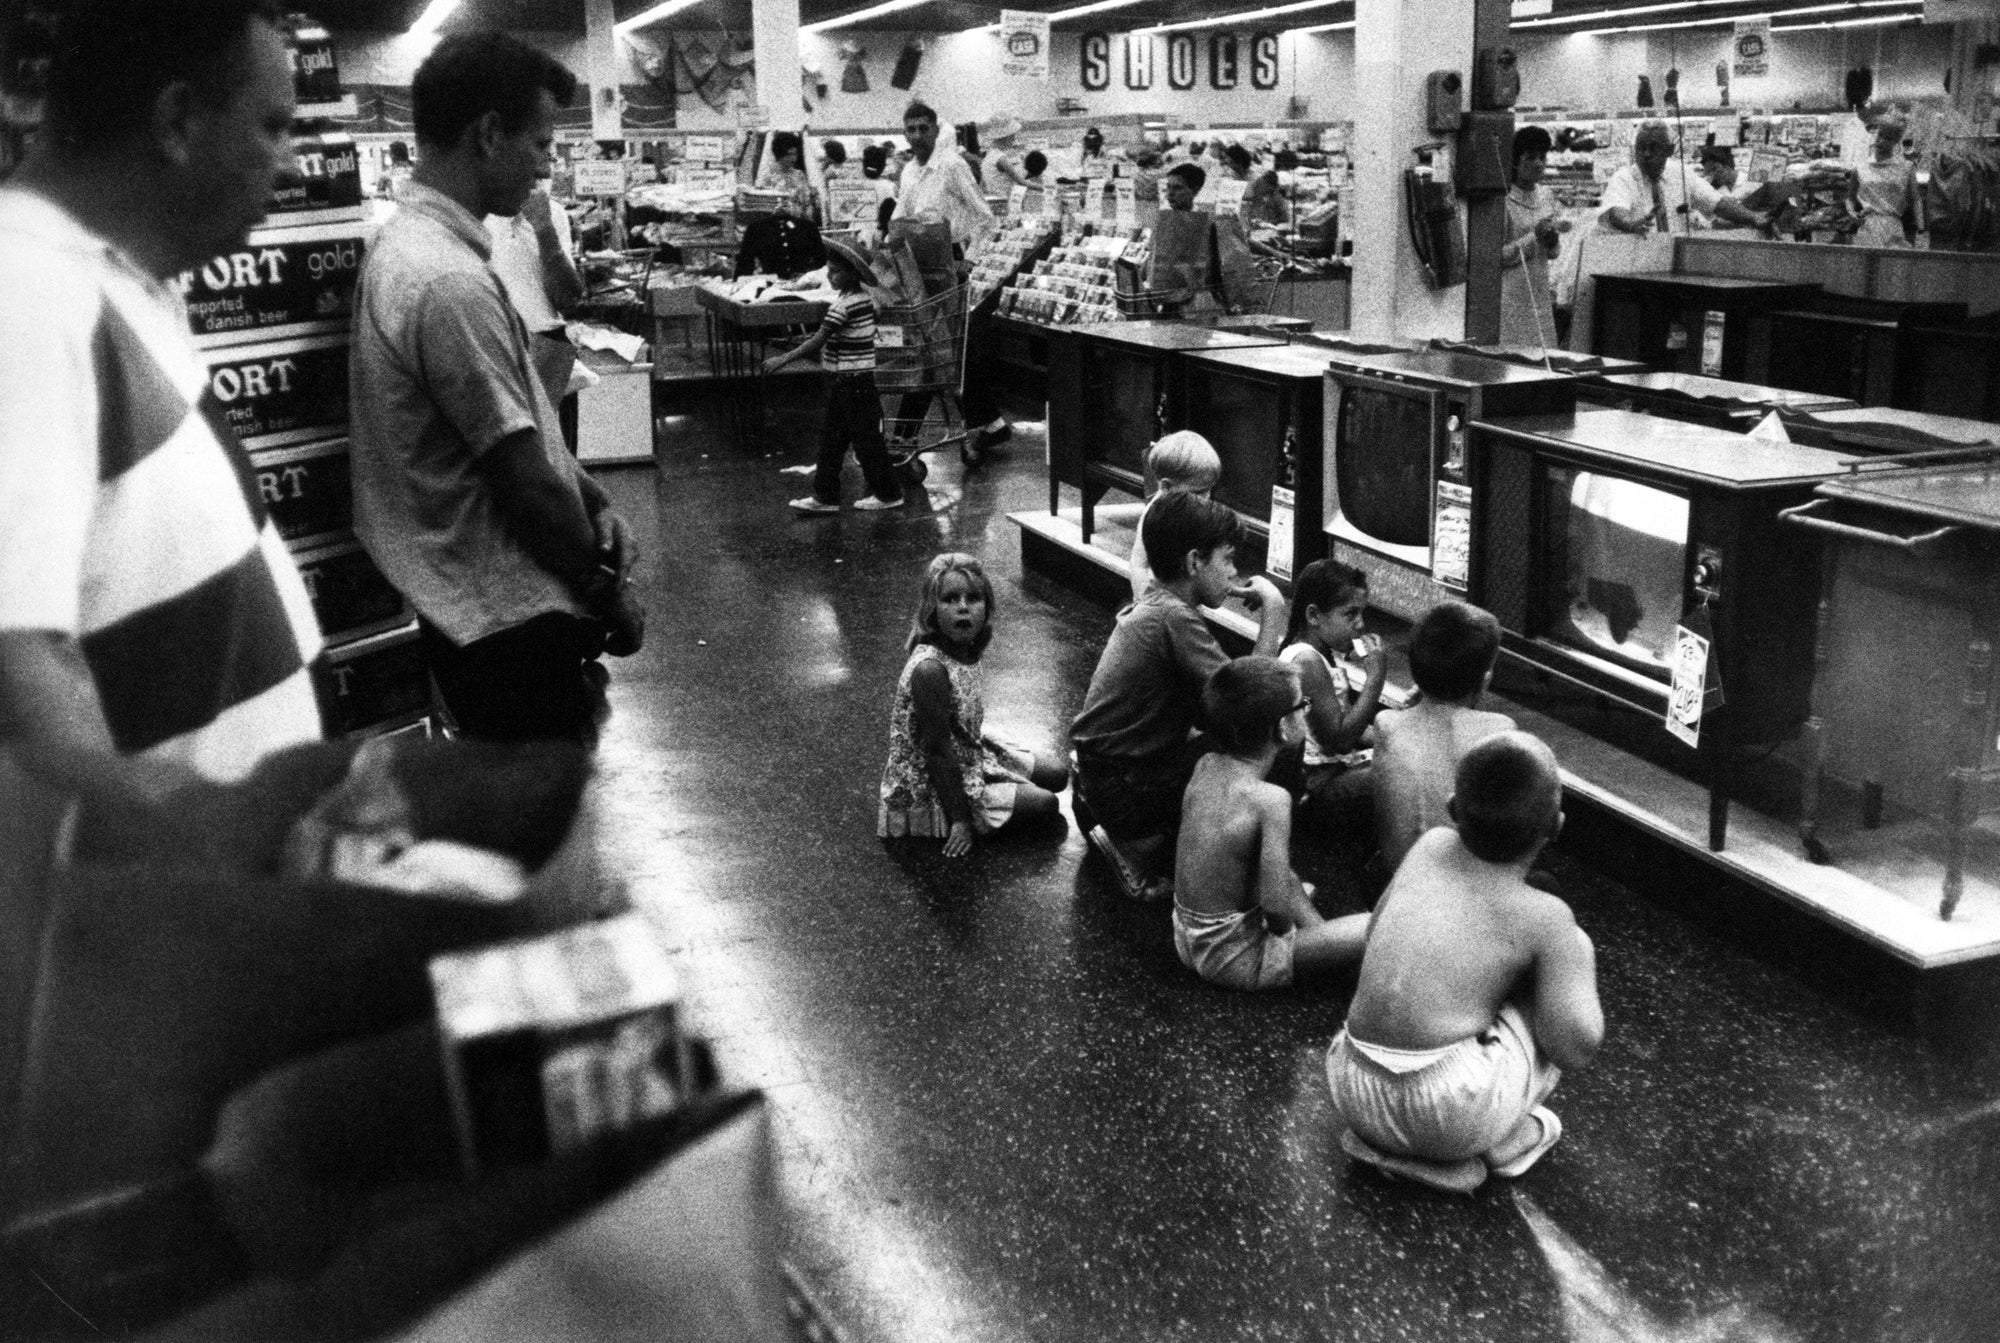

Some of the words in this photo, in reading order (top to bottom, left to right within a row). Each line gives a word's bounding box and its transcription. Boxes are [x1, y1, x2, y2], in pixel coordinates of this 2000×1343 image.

[302, 48, 334, 75] gold
[1080, 30, 1279, 91] SHOES
[327, 151, 356, 178] gold
[308, 244, 356, 280] gold
[206, 313, 253, 331] danish
[259, 310, 288, 324] beer
